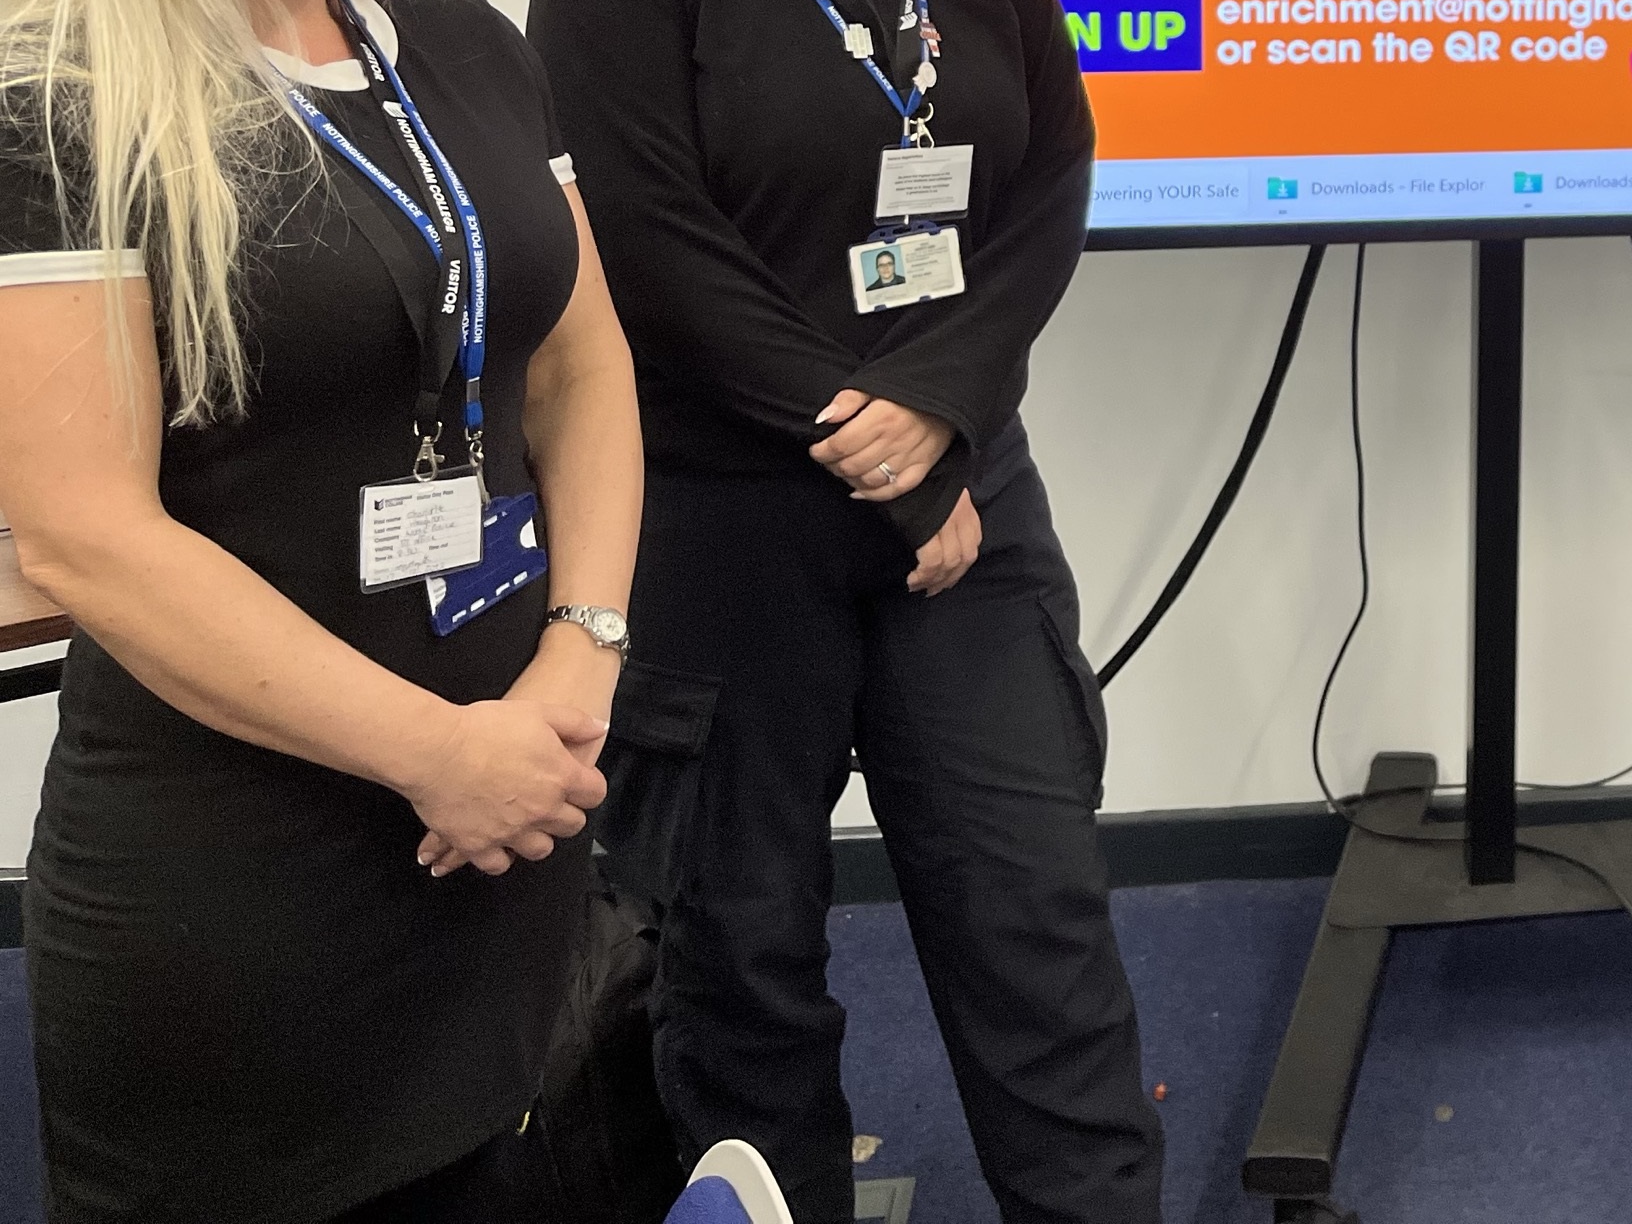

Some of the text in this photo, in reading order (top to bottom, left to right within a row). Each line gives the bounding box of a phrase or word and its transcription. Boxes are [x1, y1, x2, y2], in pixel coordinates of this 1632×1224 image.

[1119, 10, 1186, 52] UP
[1216, 30, 1607, 64] or scan the QR code
[873, 65, 893, 91] POLICE
[289, 89, 321, 118] POLICE
[322, 122, 423, 218] NOTTINGHAMSHIRE POLICE
[396, 118, 438, 184] NOTTINGHAM
[429, 184, 457, 234] COLLEGE
[1311, 180, 1394, 197] Downloads
[1410, 178, 1437, 194] File
[1440, 176, 1485, 196] Explor
[1093, 183, 1240, 203] owering YOUR Safe
[441, 259, 461, 315] VISITOR
[466, 214, 485, 344] NOTTINGHAMSHIRE POLICE
